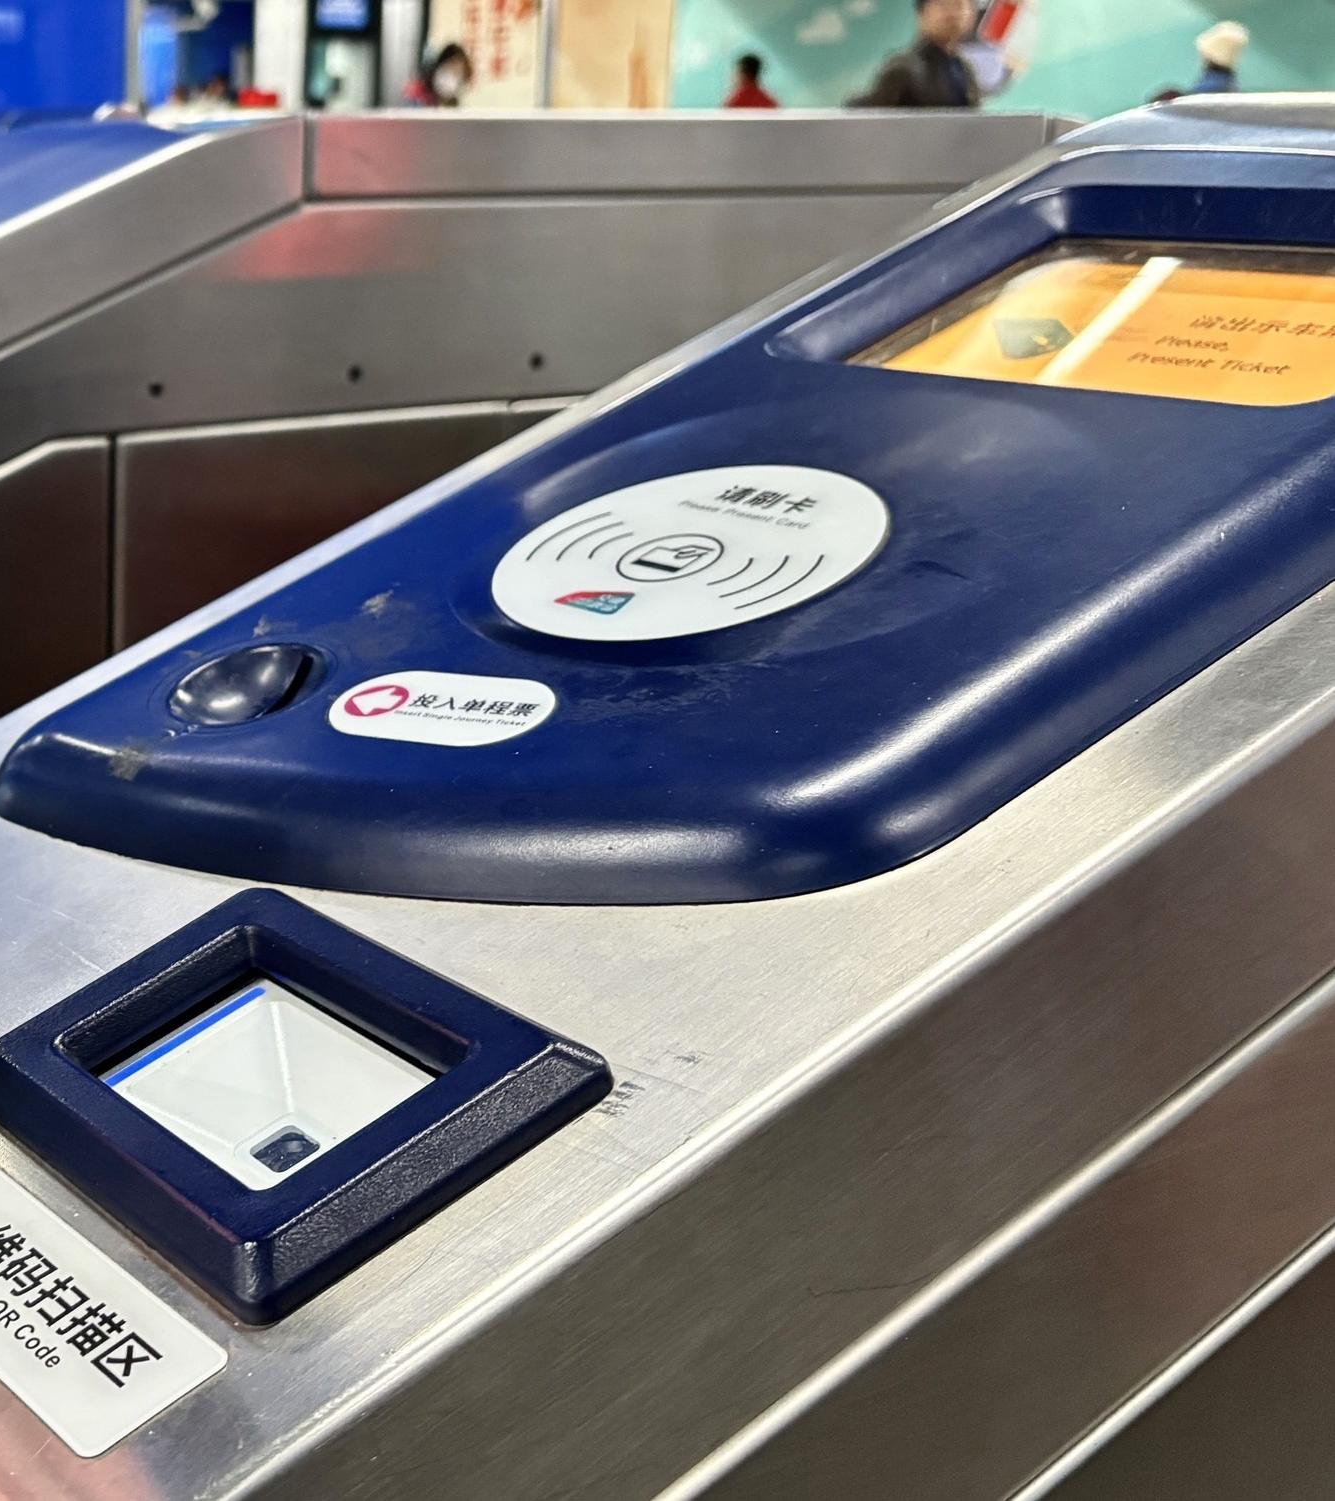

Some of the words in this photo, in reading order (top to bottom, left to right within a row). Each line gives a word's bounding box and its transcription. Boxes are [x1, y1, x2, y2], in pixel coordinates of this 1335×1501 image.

[1127, 351, 1216, 369] Present
[1220, 359, 1291, 375] Ticket
[715, 484, 818, 514] 请刷卡
[678, 499, 721, 513] Please
[722, 507, 775, 523] Present
[775, 516, 811, 530] Card
[408, 693, 541, 718] 投入单程票
[454, 716, 493, 725] Journey
[495, 718, 526, 727] Ticket
[14, 1324, 62, 1369] Code
